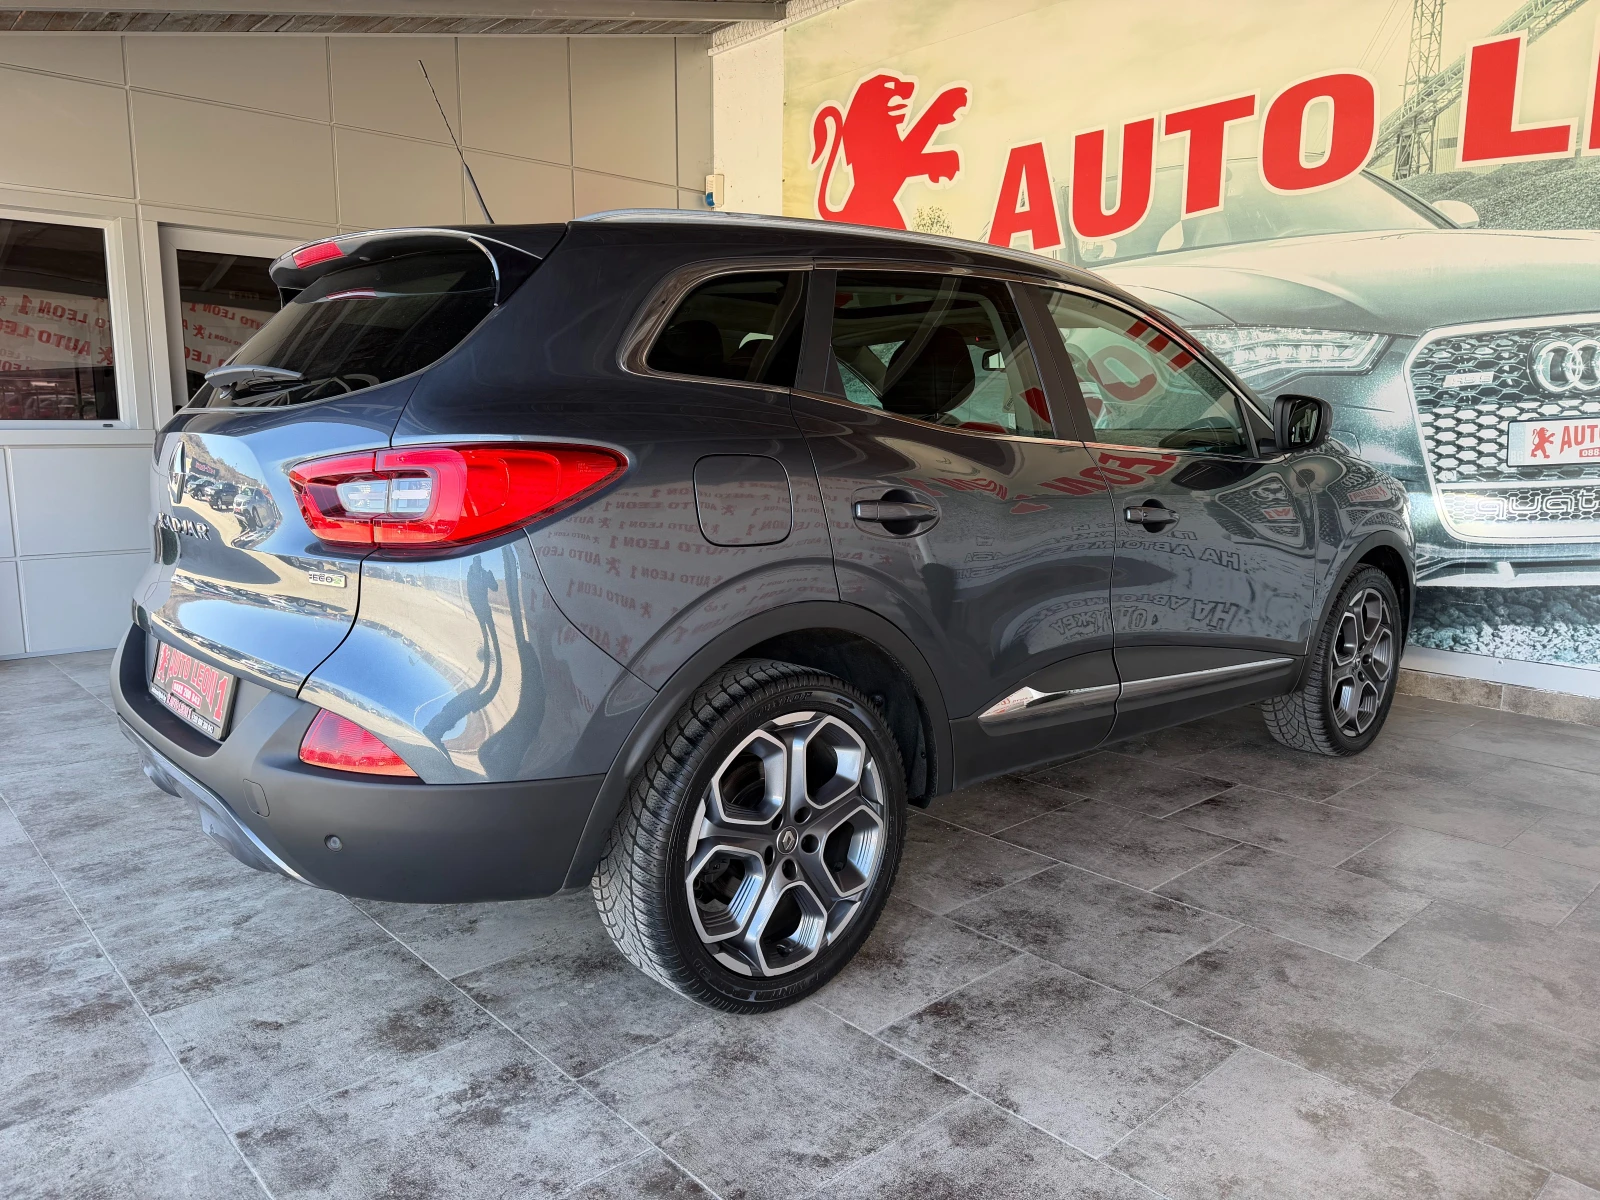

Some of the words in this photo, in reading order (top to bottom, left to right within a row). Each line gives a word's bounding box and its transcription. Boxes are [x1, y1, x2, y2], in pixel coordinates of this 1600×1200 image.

[988, 72, 1375, 251] AUTO
[1461, 36, 1600, 163] L
[1559, 424, 1600, 455] AUT
[190, 660, 219, 712] LEON
[213, 675, 229, 722] 1
